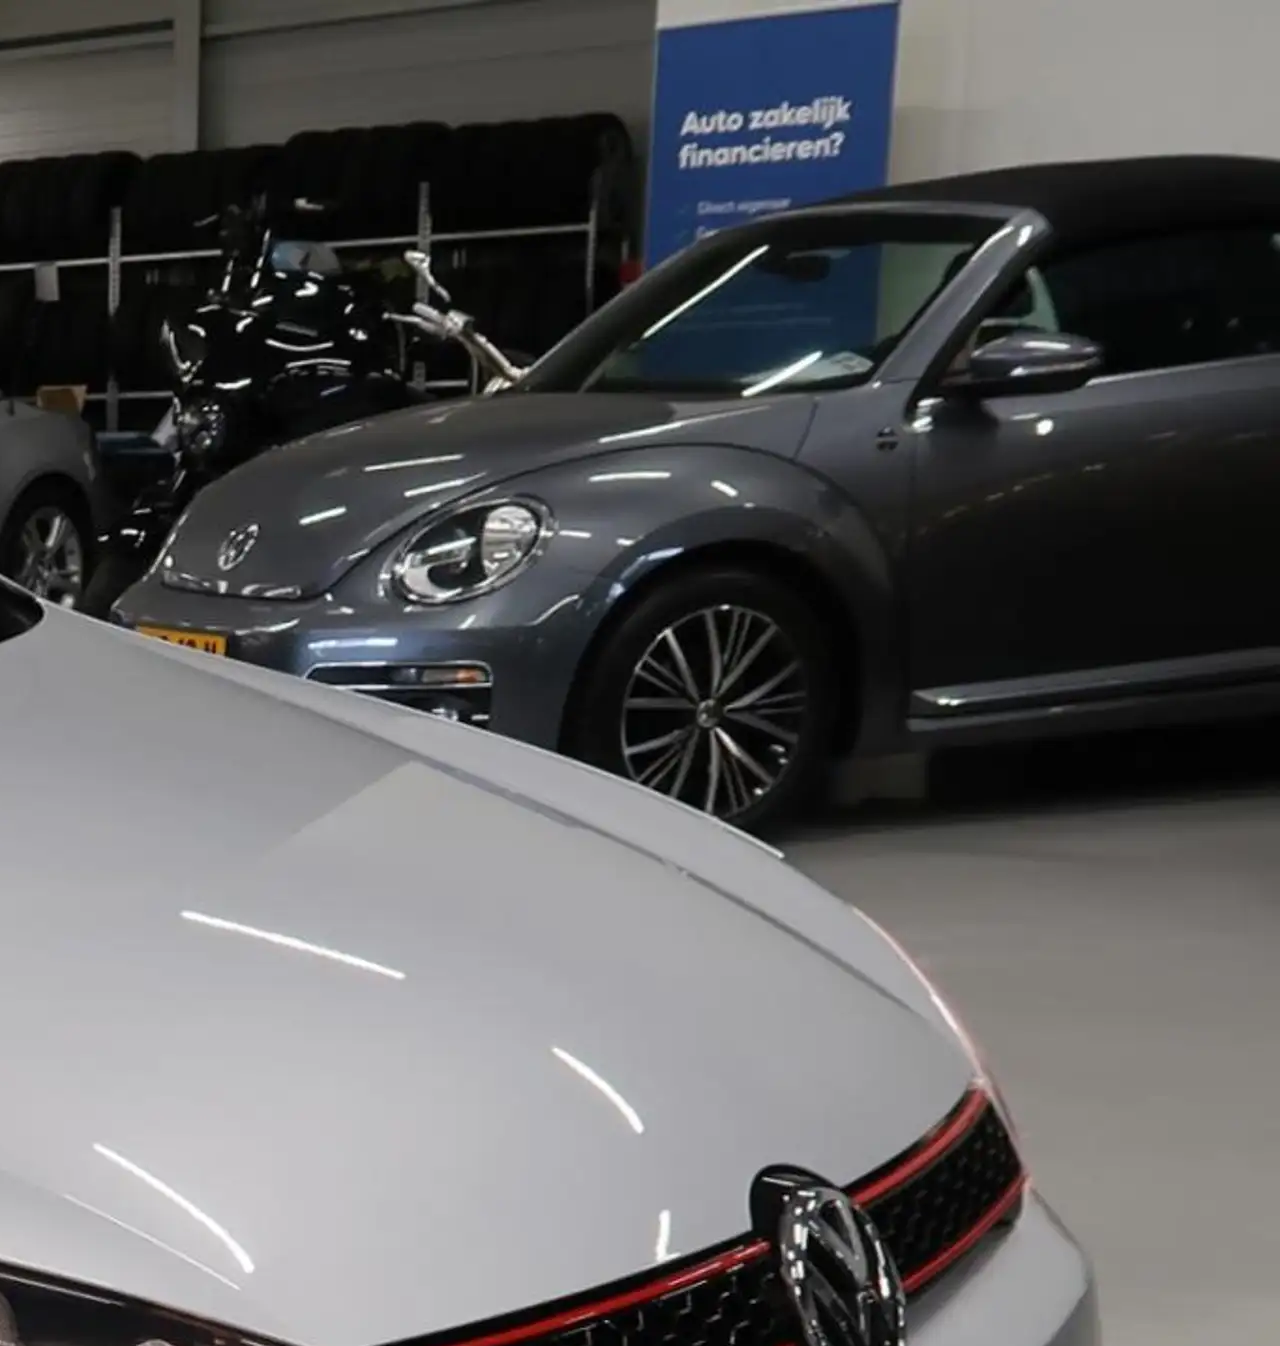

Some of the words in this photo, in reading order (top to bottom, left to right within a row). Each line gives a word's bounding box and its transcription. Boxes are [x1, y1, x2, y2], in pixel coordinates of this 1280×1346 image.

[680, 110, 744, 136] Auto
[749, 95, 852, 130] zakelijk
[679, 131, 845, 170] financieren?
